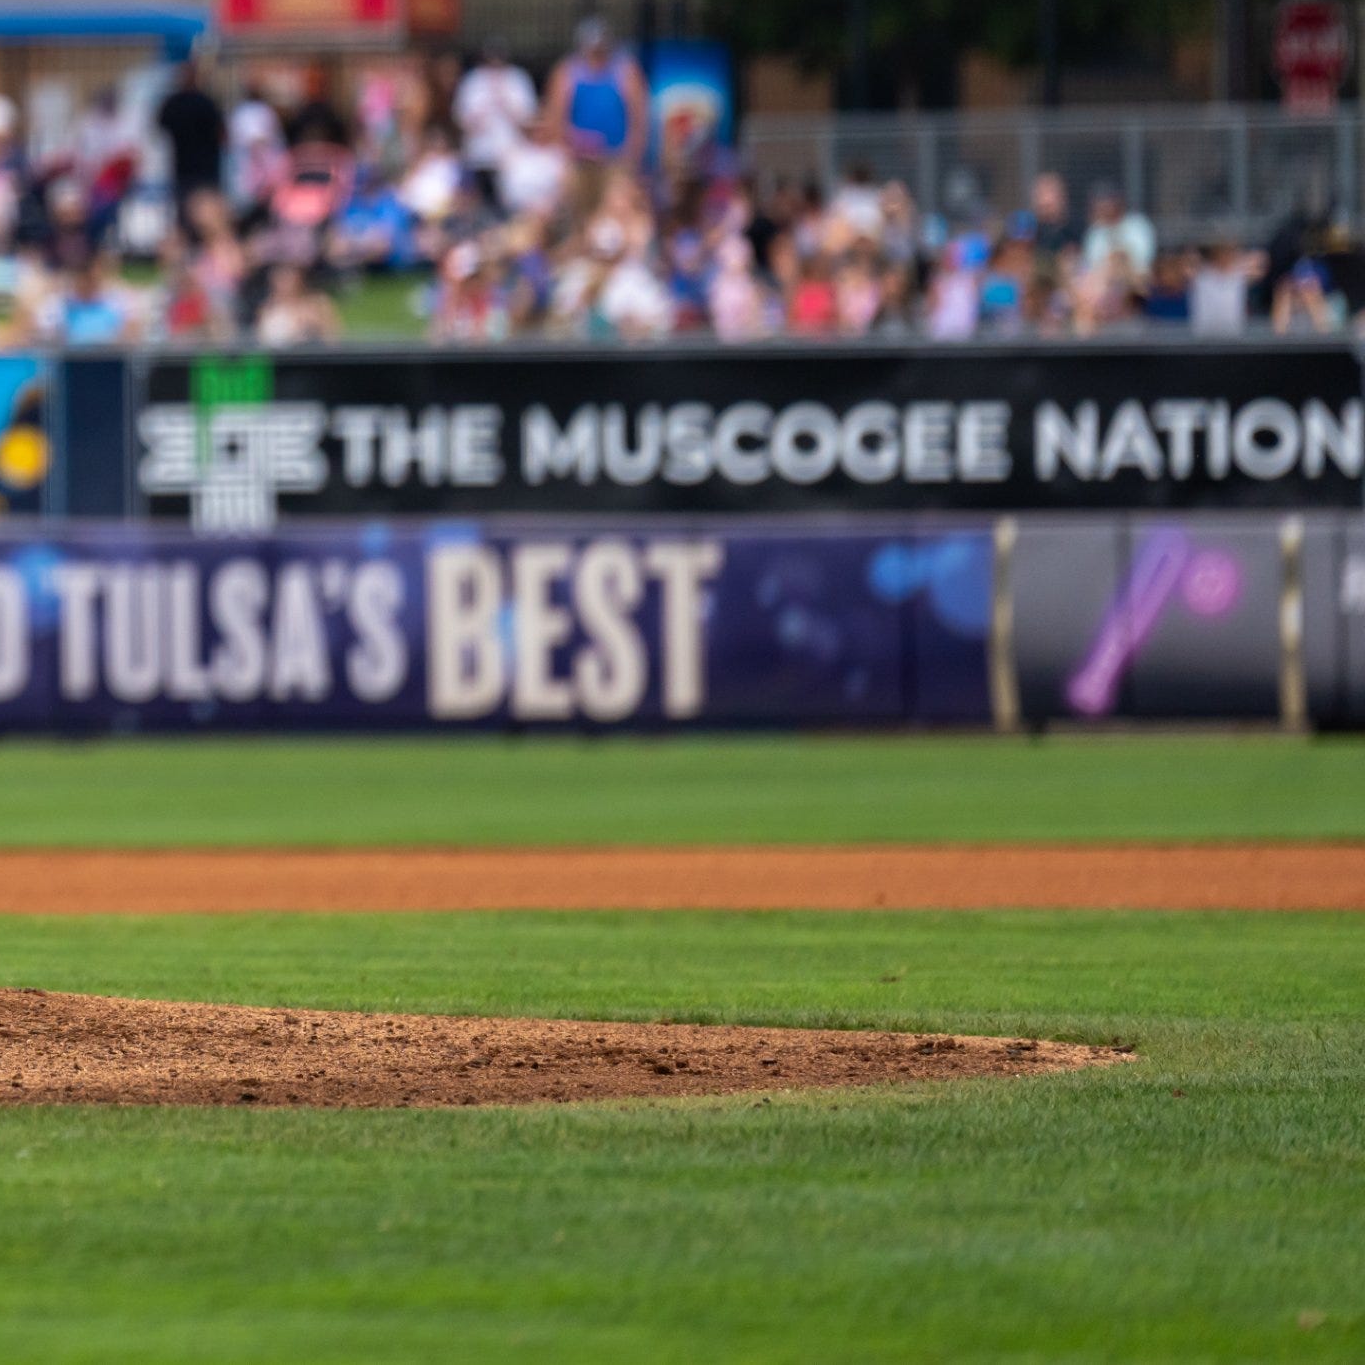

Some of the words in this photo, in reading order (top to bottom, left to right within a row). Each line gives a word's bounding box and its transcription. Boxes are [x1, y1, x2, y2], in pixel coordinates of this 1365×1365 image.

[331, 404, 502, 486] THE
[522, 401, 1011, 485] MUSCOGEE
[1034, 398, 1364, 484] NATION
[57, 560, 408, 703] TULSA'S
[425, 540, 724, 720] BEST
